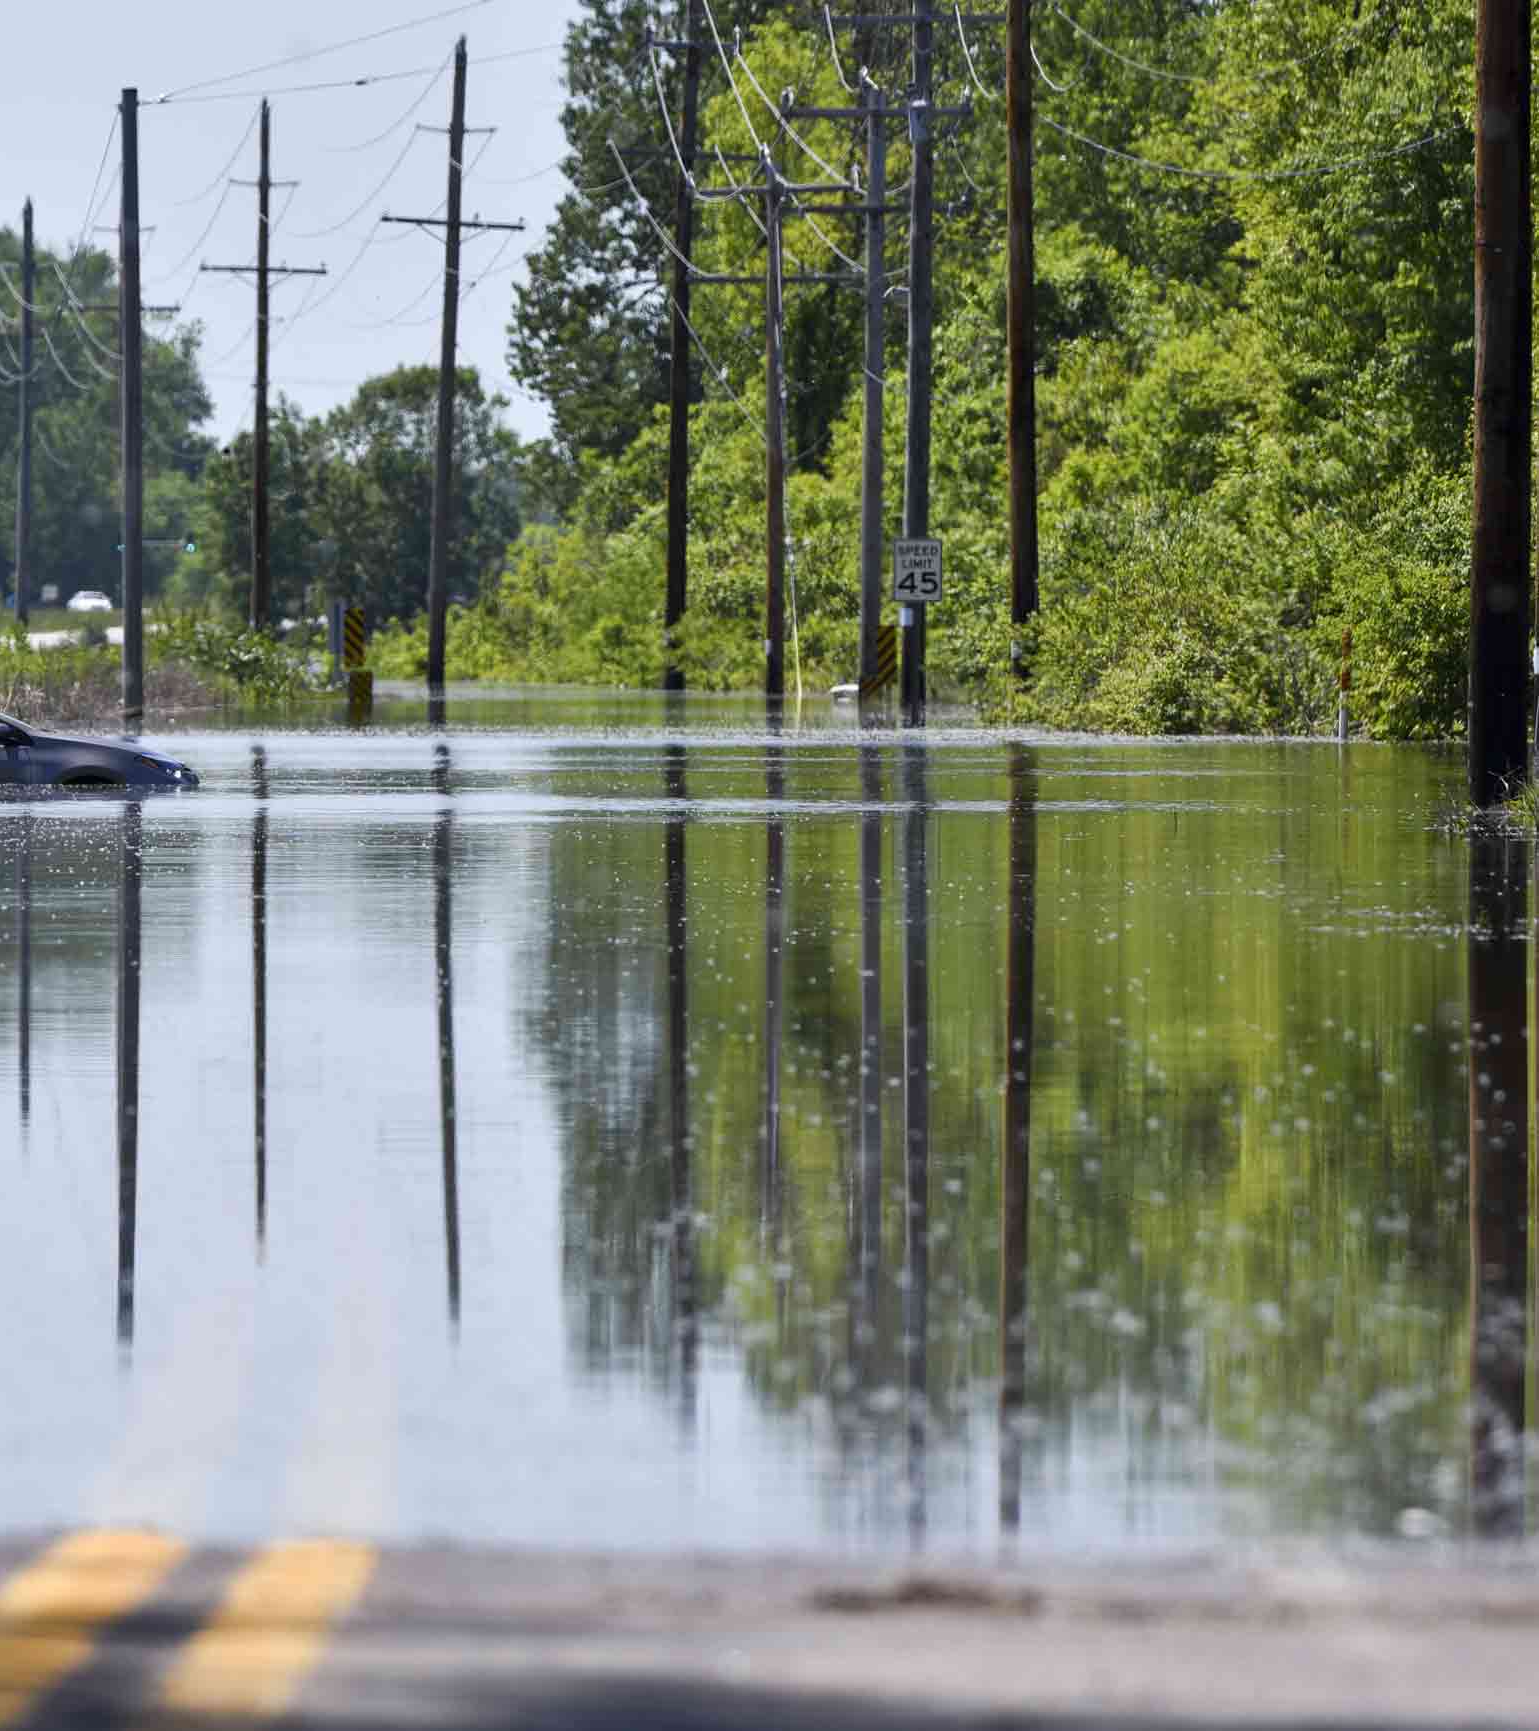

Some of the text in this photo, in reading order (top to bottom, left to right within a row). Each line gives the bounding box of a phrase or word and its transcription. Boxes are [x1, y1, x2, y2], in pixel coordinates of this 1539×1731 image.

[898, 544, 939, 556] SPEED
[902, 558, 934, 569] LIMIT
[898, 572, 938, 594] 45
